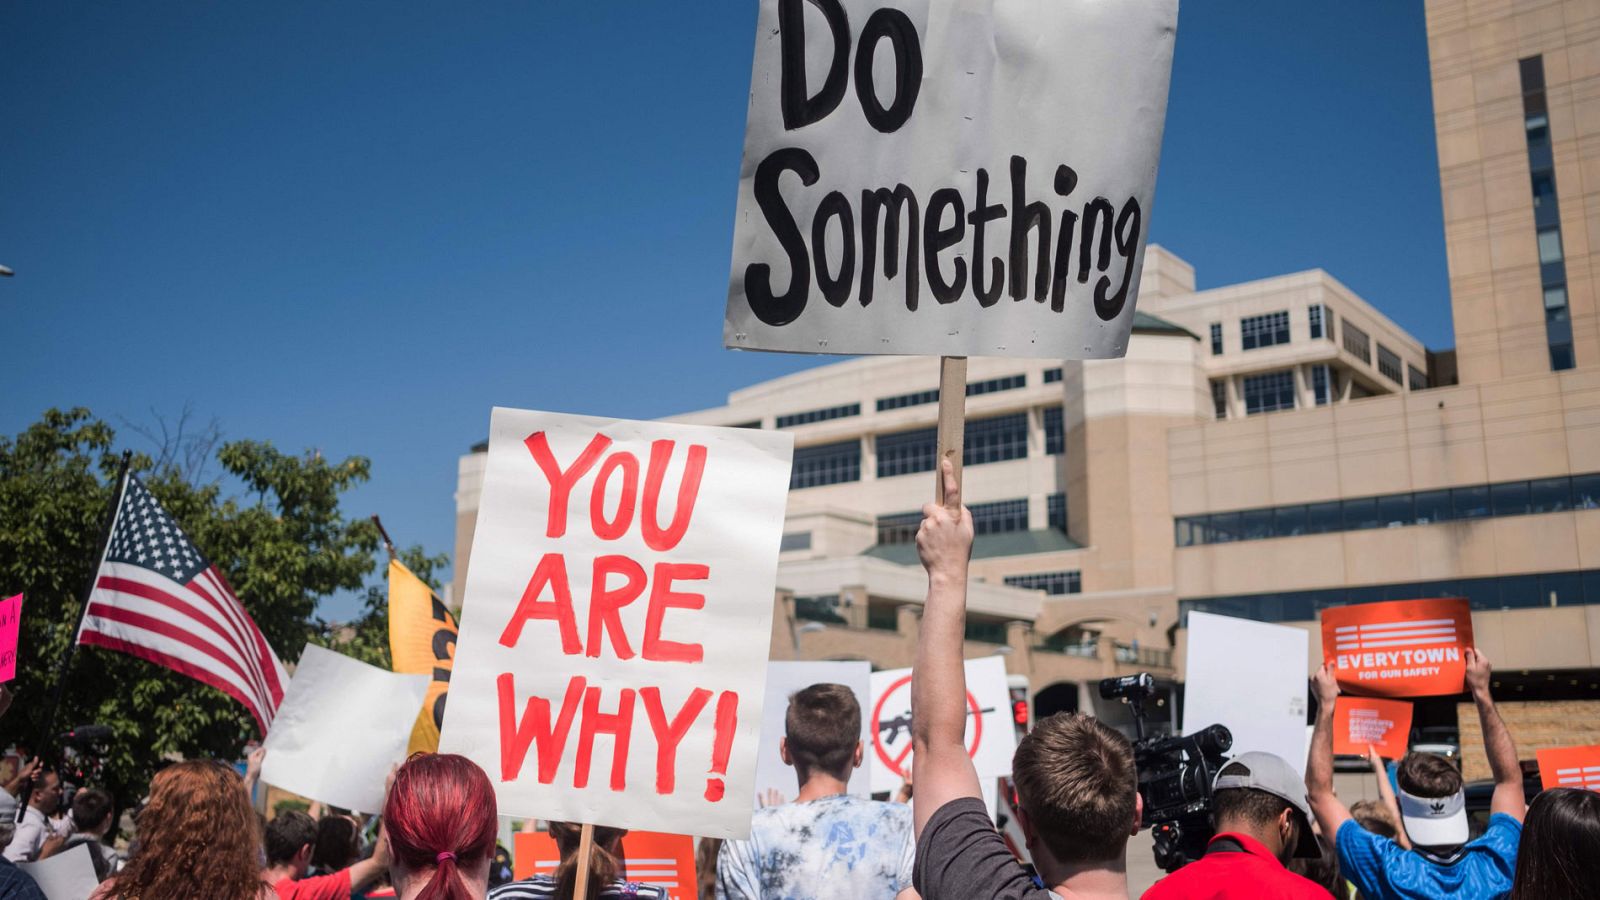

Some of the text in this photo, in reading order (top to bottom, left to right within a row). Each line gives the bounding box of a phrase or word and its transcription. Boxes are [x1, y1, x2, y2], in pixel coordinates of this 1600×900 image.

[778, 0, 923, 133] Do
[744, 147, 1141, 326] Something
[524, 431, 708, 552] YOU
[499, 553, 710, 663] ARE
[1358, 667, 1440, 680] FOR GUN SAFETY
[497, 672, 738, 803] WHY!
